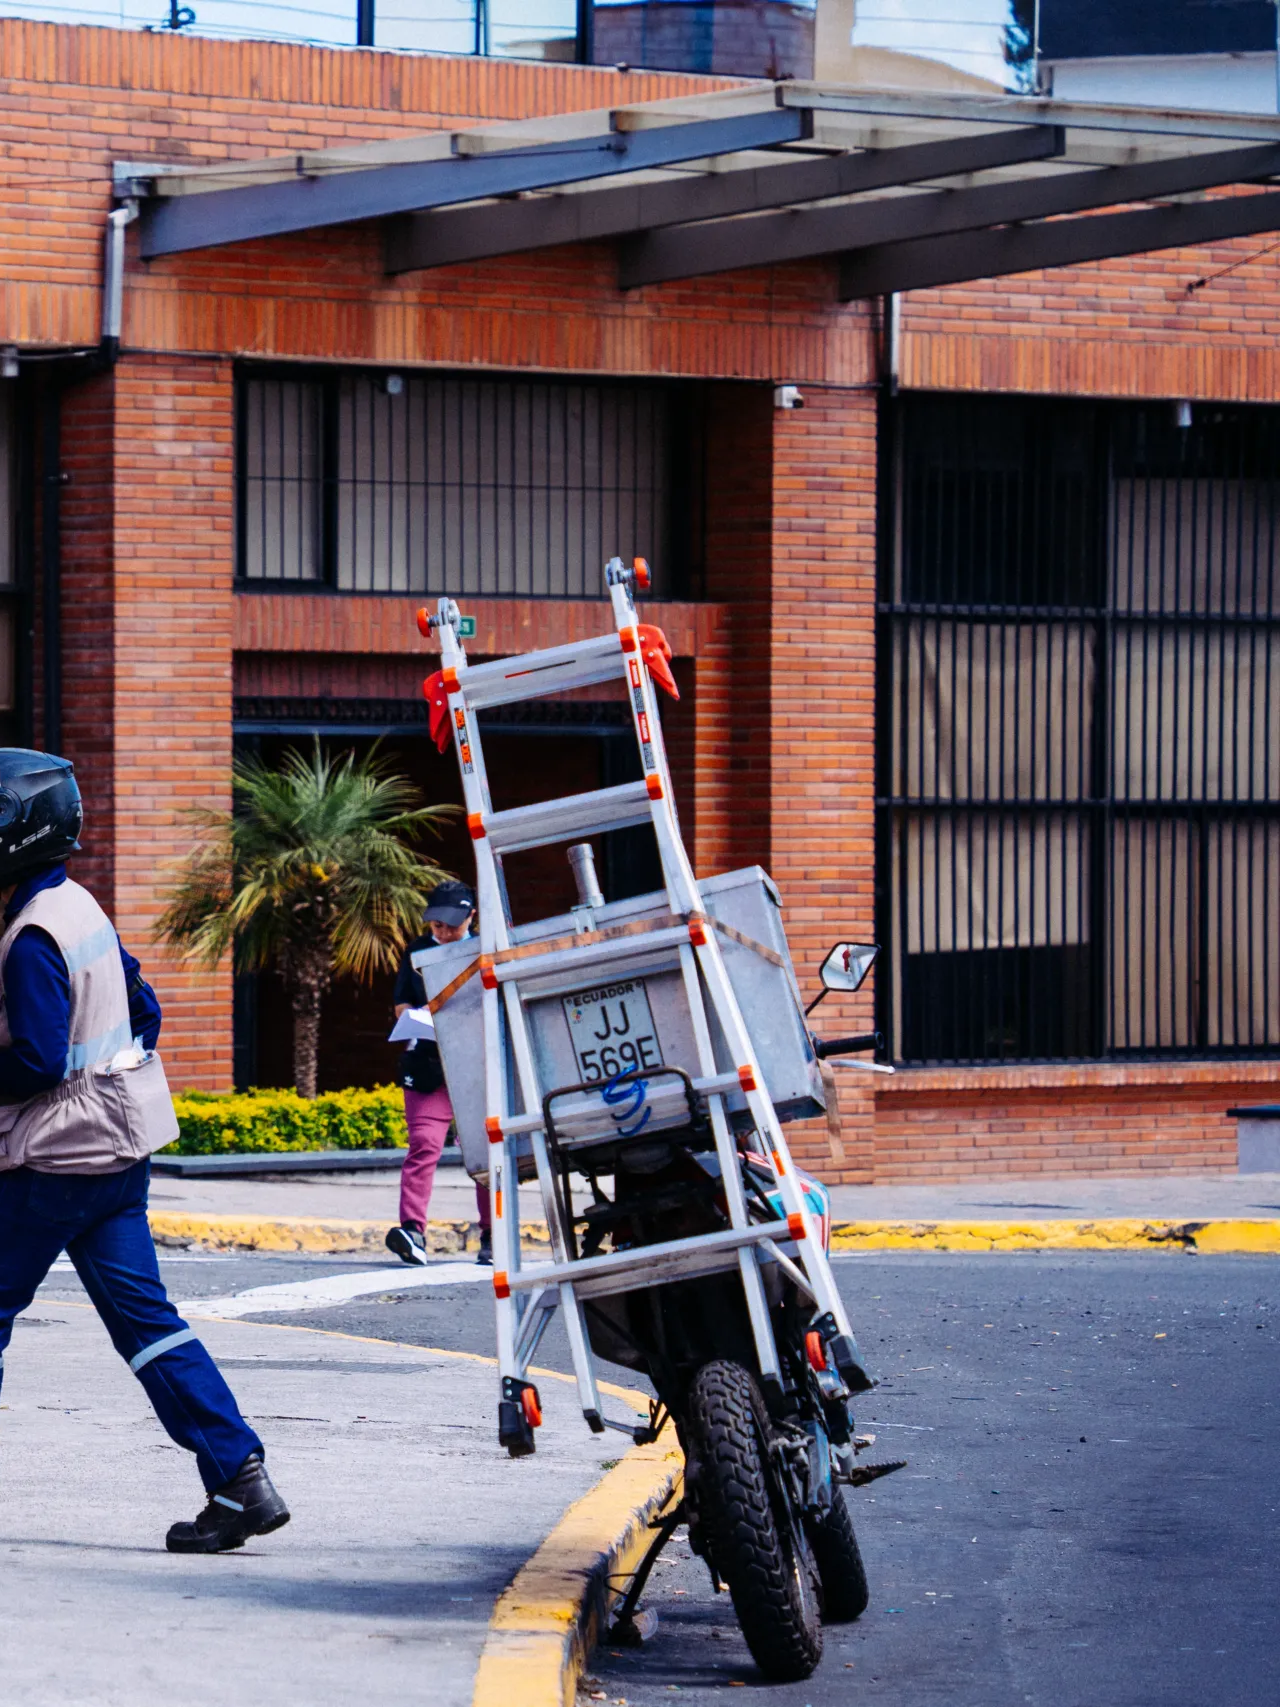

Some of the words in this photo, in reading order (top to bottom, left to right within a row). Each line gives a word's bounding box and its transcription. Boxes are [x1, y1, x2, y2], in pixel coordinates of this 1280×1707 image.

[573, 983, 635, 1007] ECUADOR
[594, 1001, 630, 1040] JJ
[580, 1035, 661, 1082] 569E
